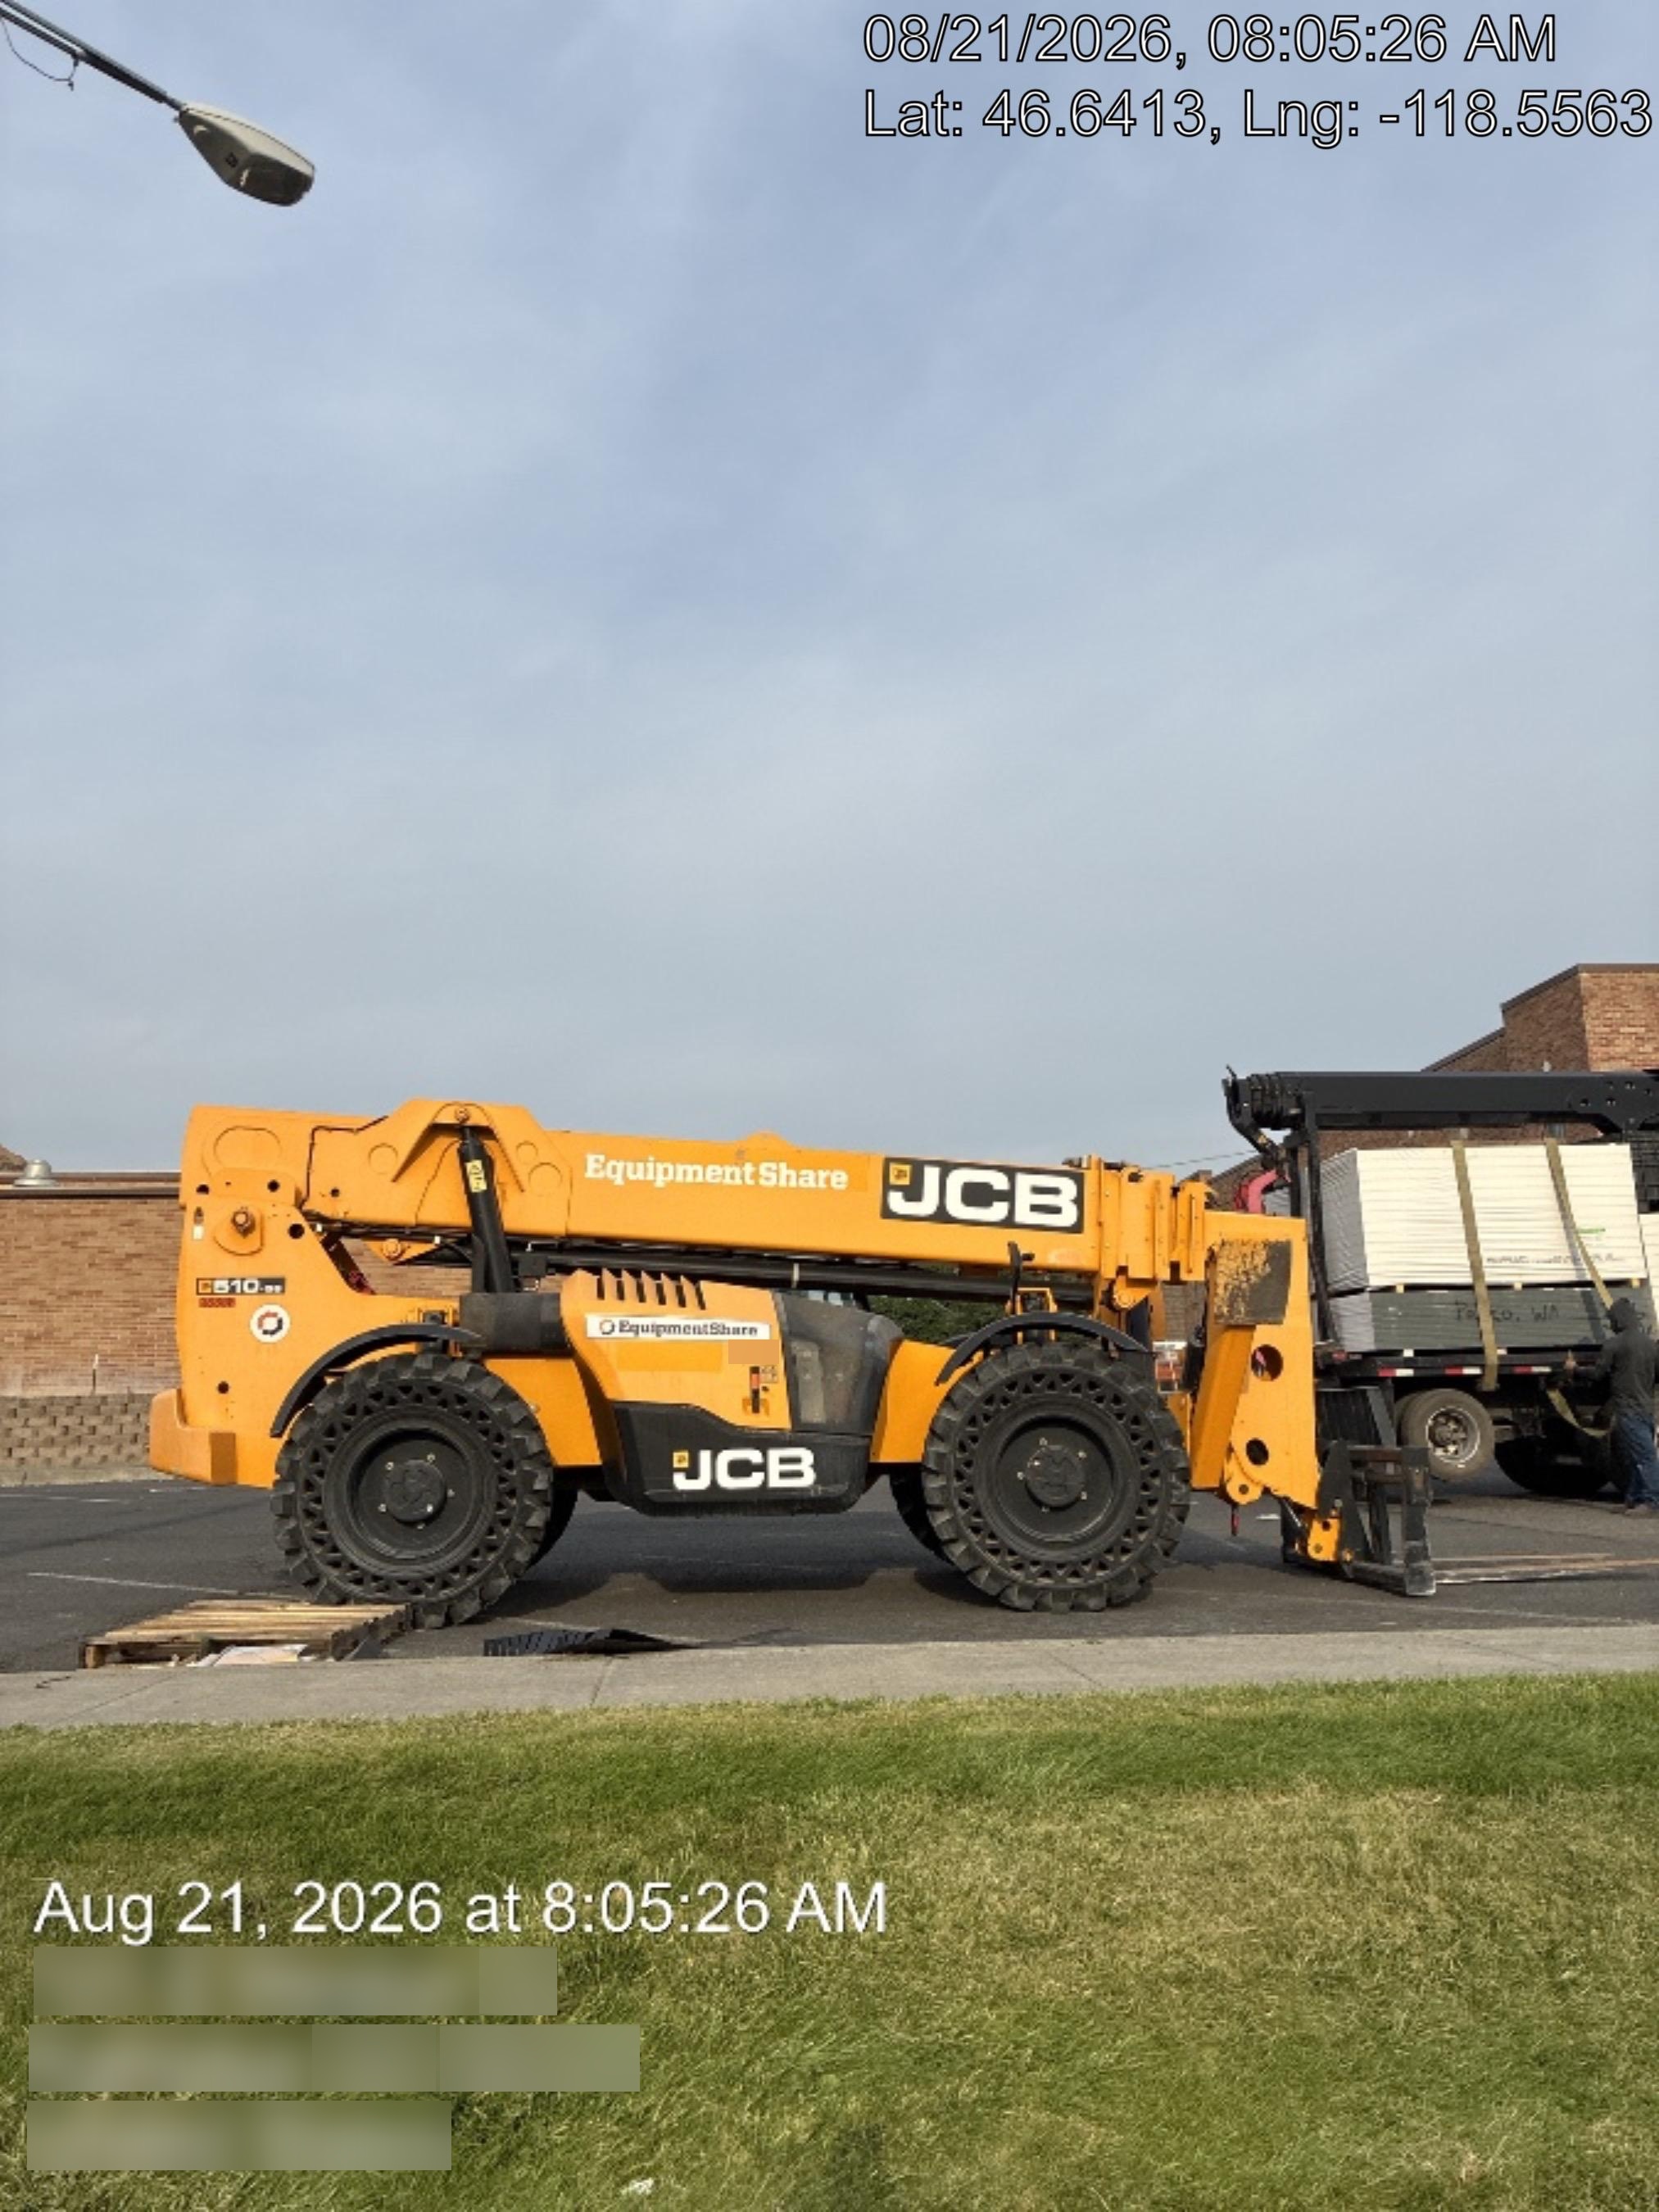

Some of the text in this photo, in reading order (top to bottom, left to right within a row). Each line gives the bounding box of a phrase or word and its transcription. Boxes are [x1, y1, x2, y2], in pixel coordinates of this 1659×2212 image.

[887, 1164, 1078, 1227] JCB
[619, 1320, 758, 1338] EquipmentShare
[673, 1448, 816, 1490] JCB
